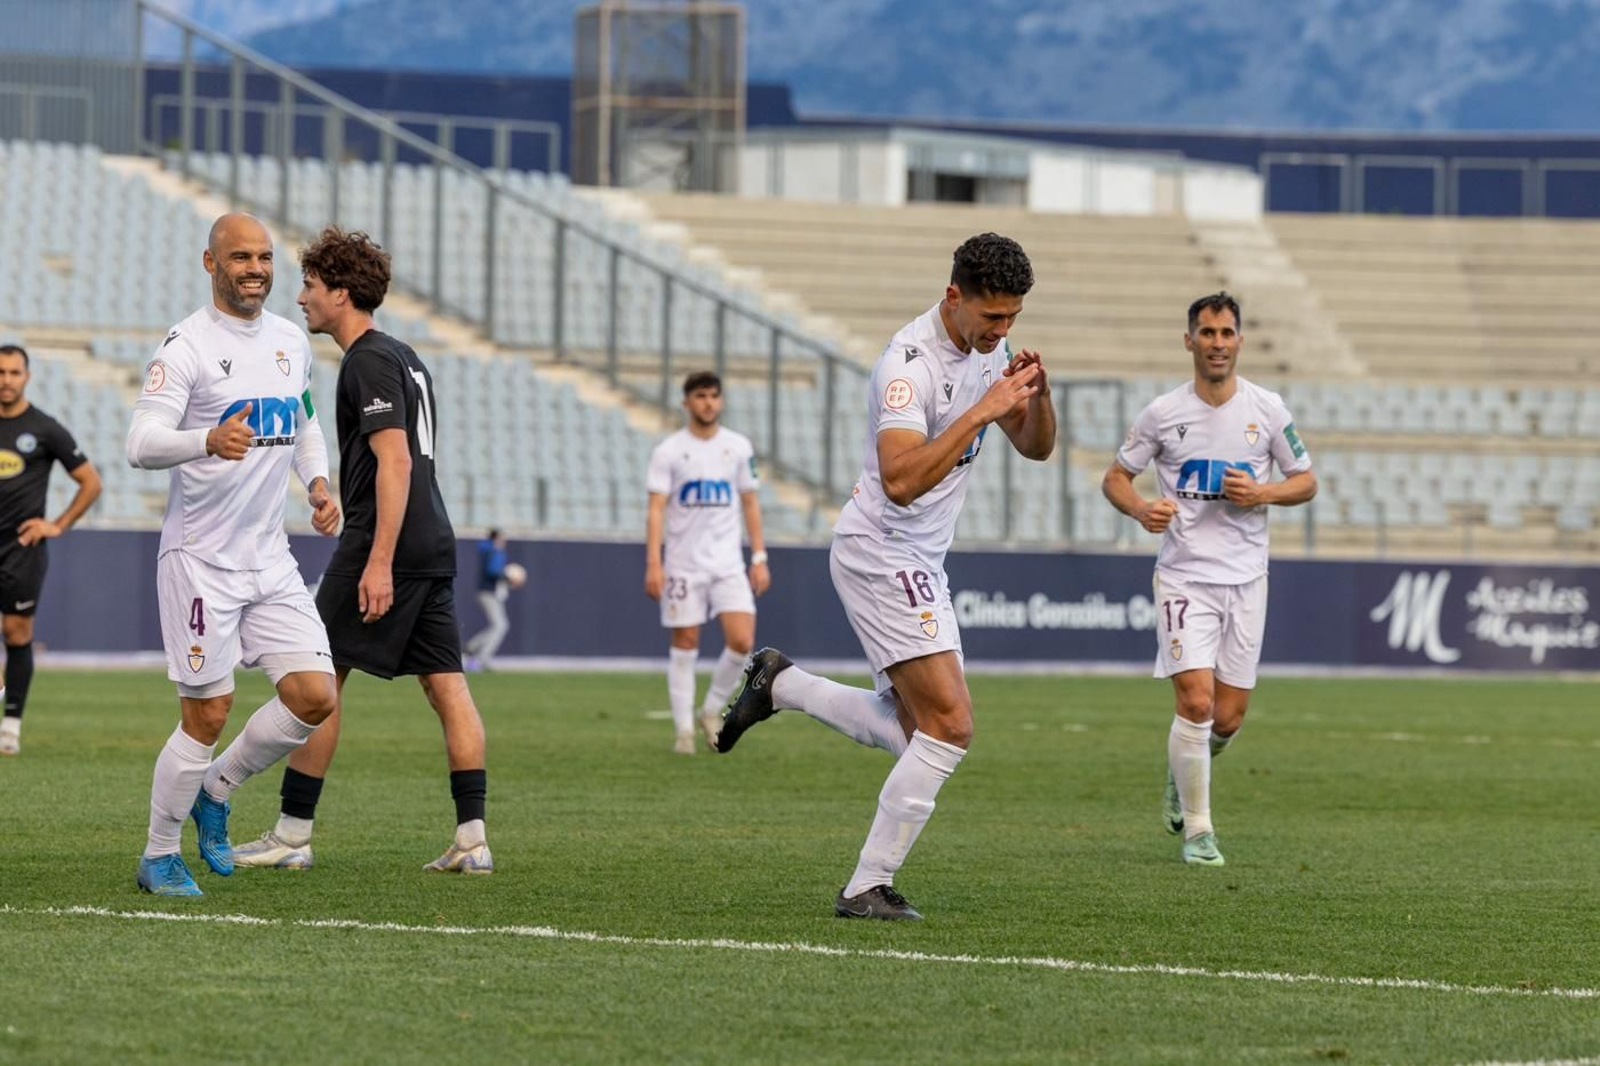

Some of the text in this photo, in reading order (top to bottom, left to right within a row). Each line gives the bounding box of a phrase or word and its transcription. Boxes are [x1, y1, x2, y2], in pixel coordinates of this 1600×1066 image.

[667, 576, 688, 601] 23
[895, 569, 935, 608] 16
[189, 597, 206, 636] 4
[1163, 598, 1189, 632] 17
